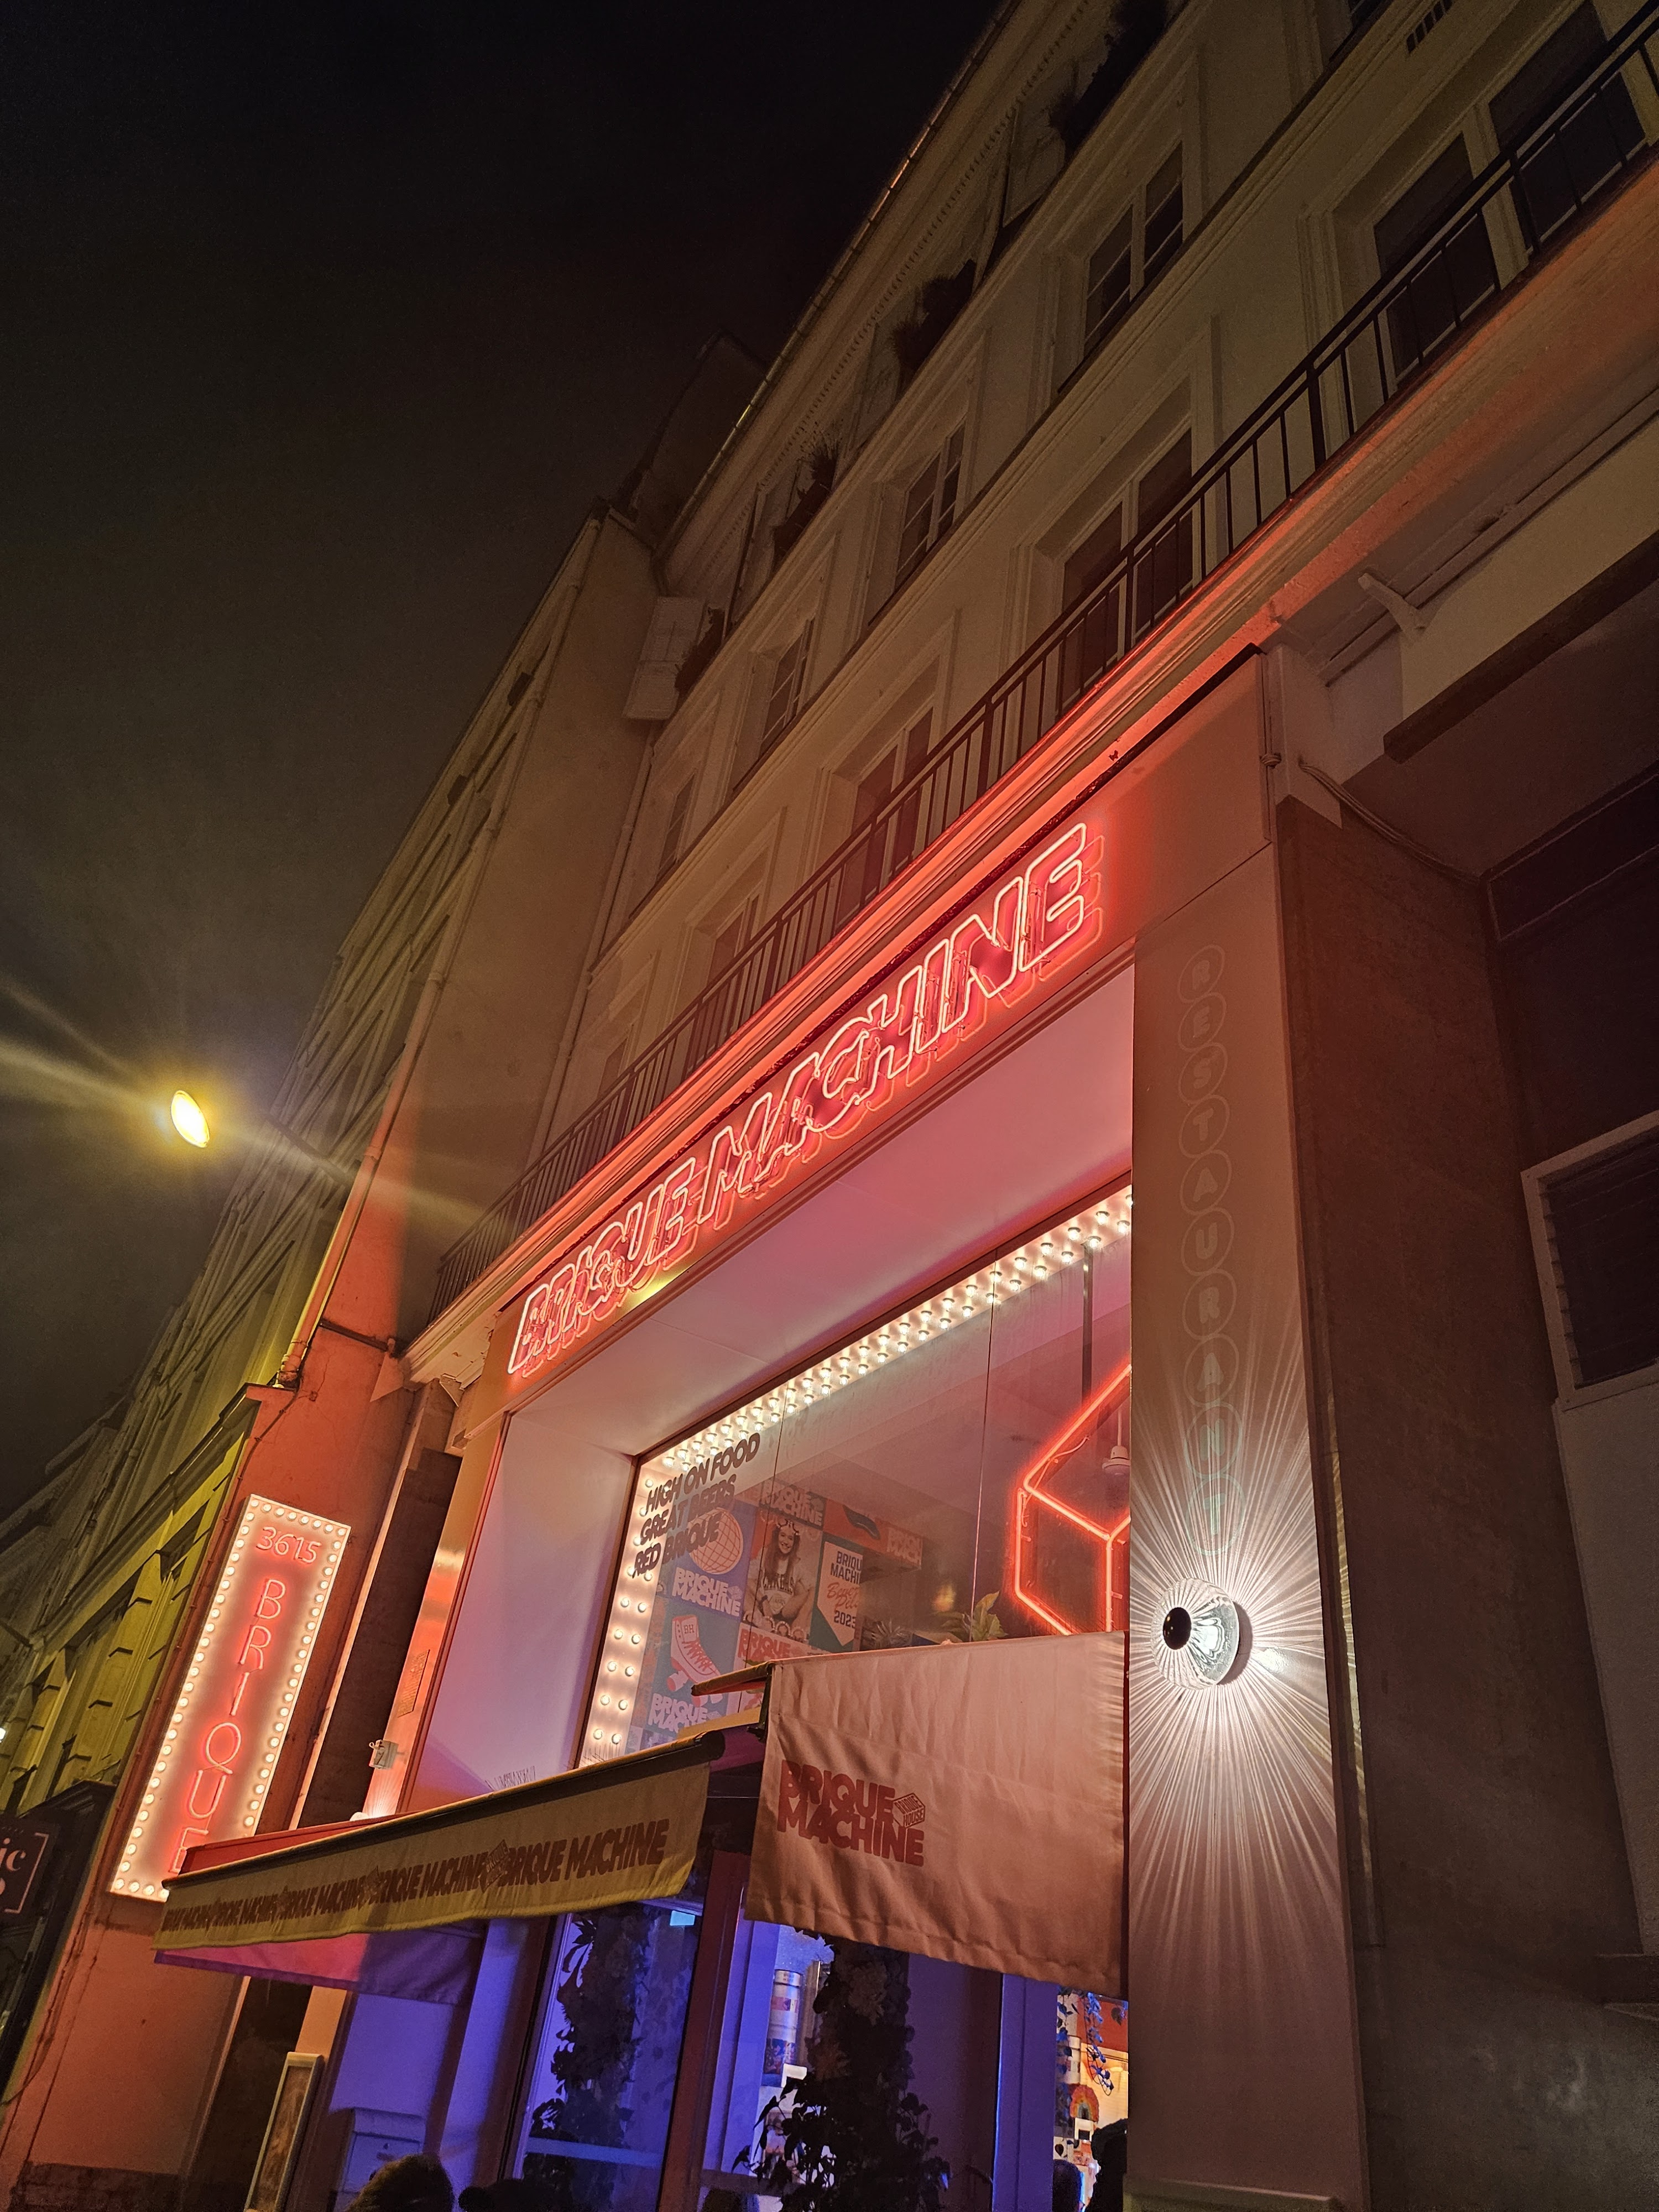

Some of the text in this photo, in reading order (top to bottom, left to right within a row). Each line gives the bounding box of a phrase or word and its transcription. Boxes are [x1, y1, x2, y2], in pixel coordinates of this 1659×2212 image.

[508, 823, 1088, 1374] BRIQUE MACHINE
[646, 1433, 760, 1516] HIGH ON FOOD
[640, 1474, 737, 1546] GREAT BEERS
[255, 1526, 322, 1566] 3615
[632, 1513, 723, 1578] RED BRIQUE
[837, 1551, 862, 1571] BRIQU
[674, 1567, 729, 1595] BRIQUE
[831, 1563, 861, 1585] MACHI
[672, 1582, 741, 1616] MACHINE
[741, 1629, 791, 1657] BRIQUE
[169, 1578, 288, 1874] BRIQUE
[652, 1693, 708, 1723] BRIQUE
[779, 1760, 895, 1818] BRIQUE
[778, 1793, 925, 1866] MACHINE
[903, 1808, 924, 1827] HOUSE
[0, 1837, 27, 1872] ic
[499, 1839, 566, 1887] BRIQUE
[564, 1818, 670, 1881] MACHINE
